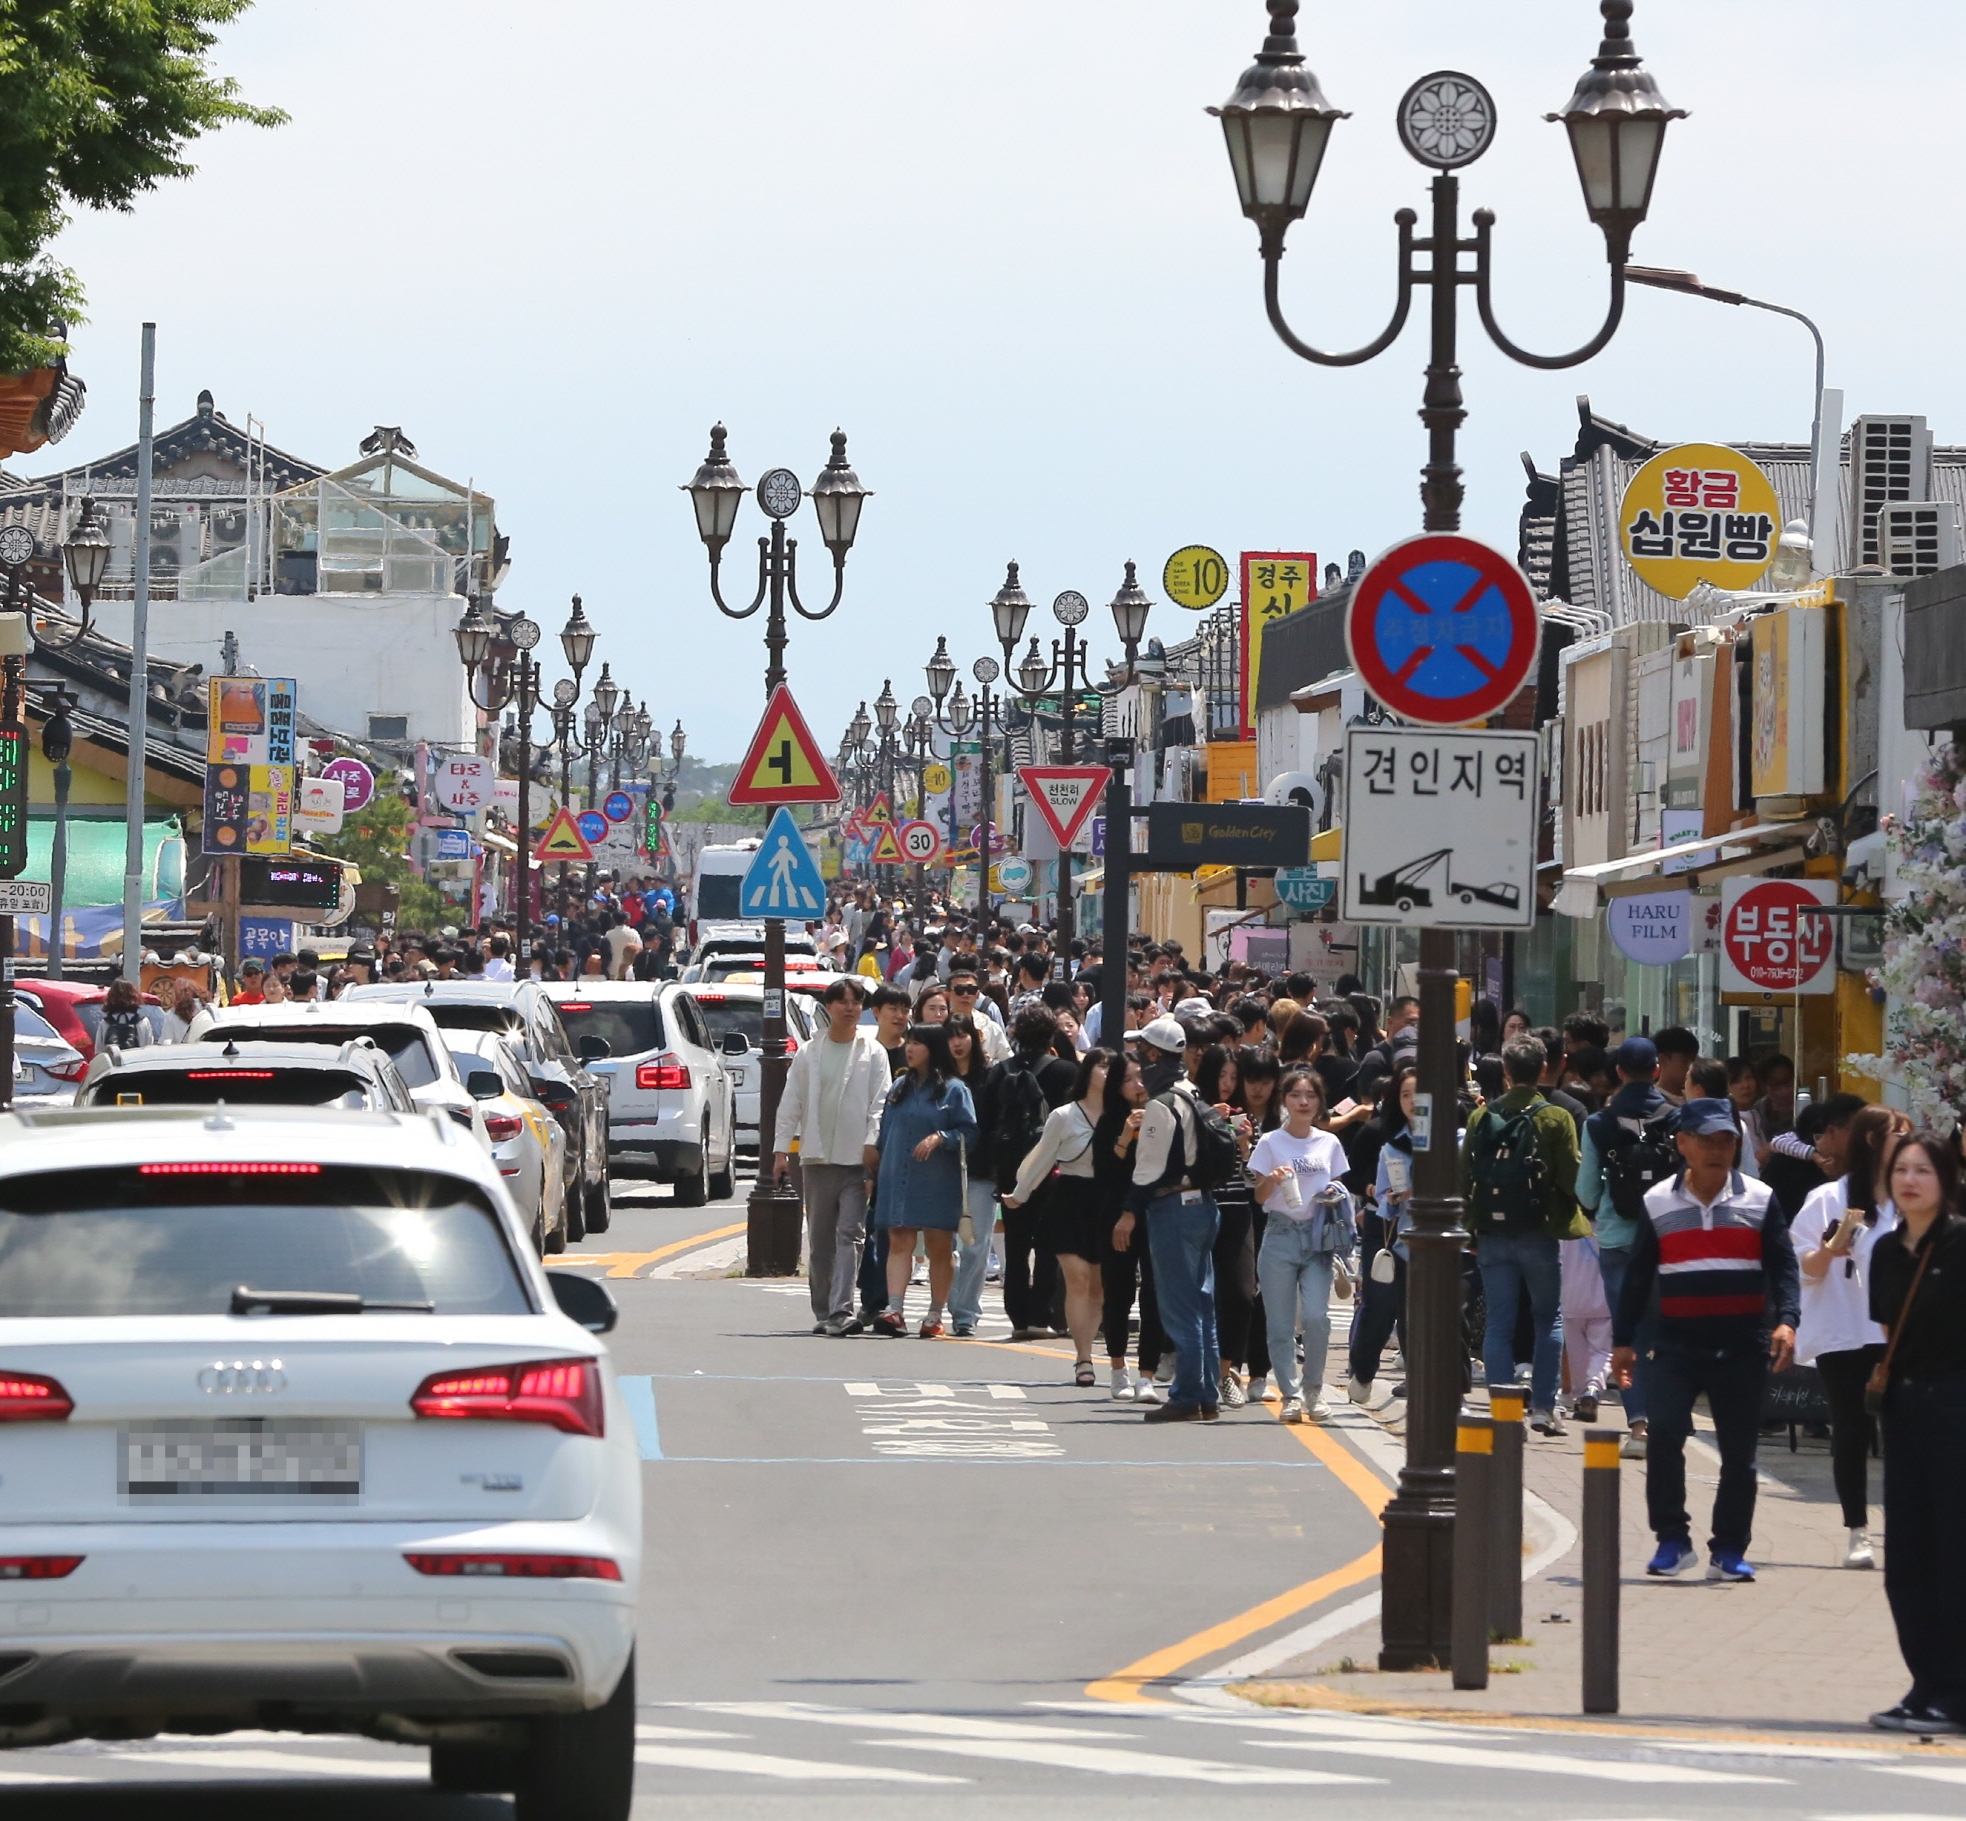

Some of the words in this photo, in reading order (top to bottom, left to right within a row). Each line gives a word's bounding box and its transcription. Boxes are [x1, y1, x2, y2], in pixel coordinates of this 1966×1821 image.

[1664, 469, 1738, 509] 황금
[1629, 510, 1773, 561] 십원빵
[1193, 558, 1221, 595] 10
[1257, 563, 1302, 590] 경주
[269, 693, 292, 763] 물품보관
[330, 770, 361, 783] 사주
[450, 763, 481, 776] 타로
[1363, 747, 1526, 801] 견인지역
[461, 779, 470, 789] &
[1049, 783, 1079, 796] 천천히
[451, 791, 480, 805] 사주
[910, 834, 930, 851] 30
[1286, 882, 1325, 904] 사진
[1628, 904, 1681, 919] HARU
[244, 927, 289, 950] 골목안
[1632, 925, 1677, 939] FILM
[1732, 906, 1824, 964] 부동산
